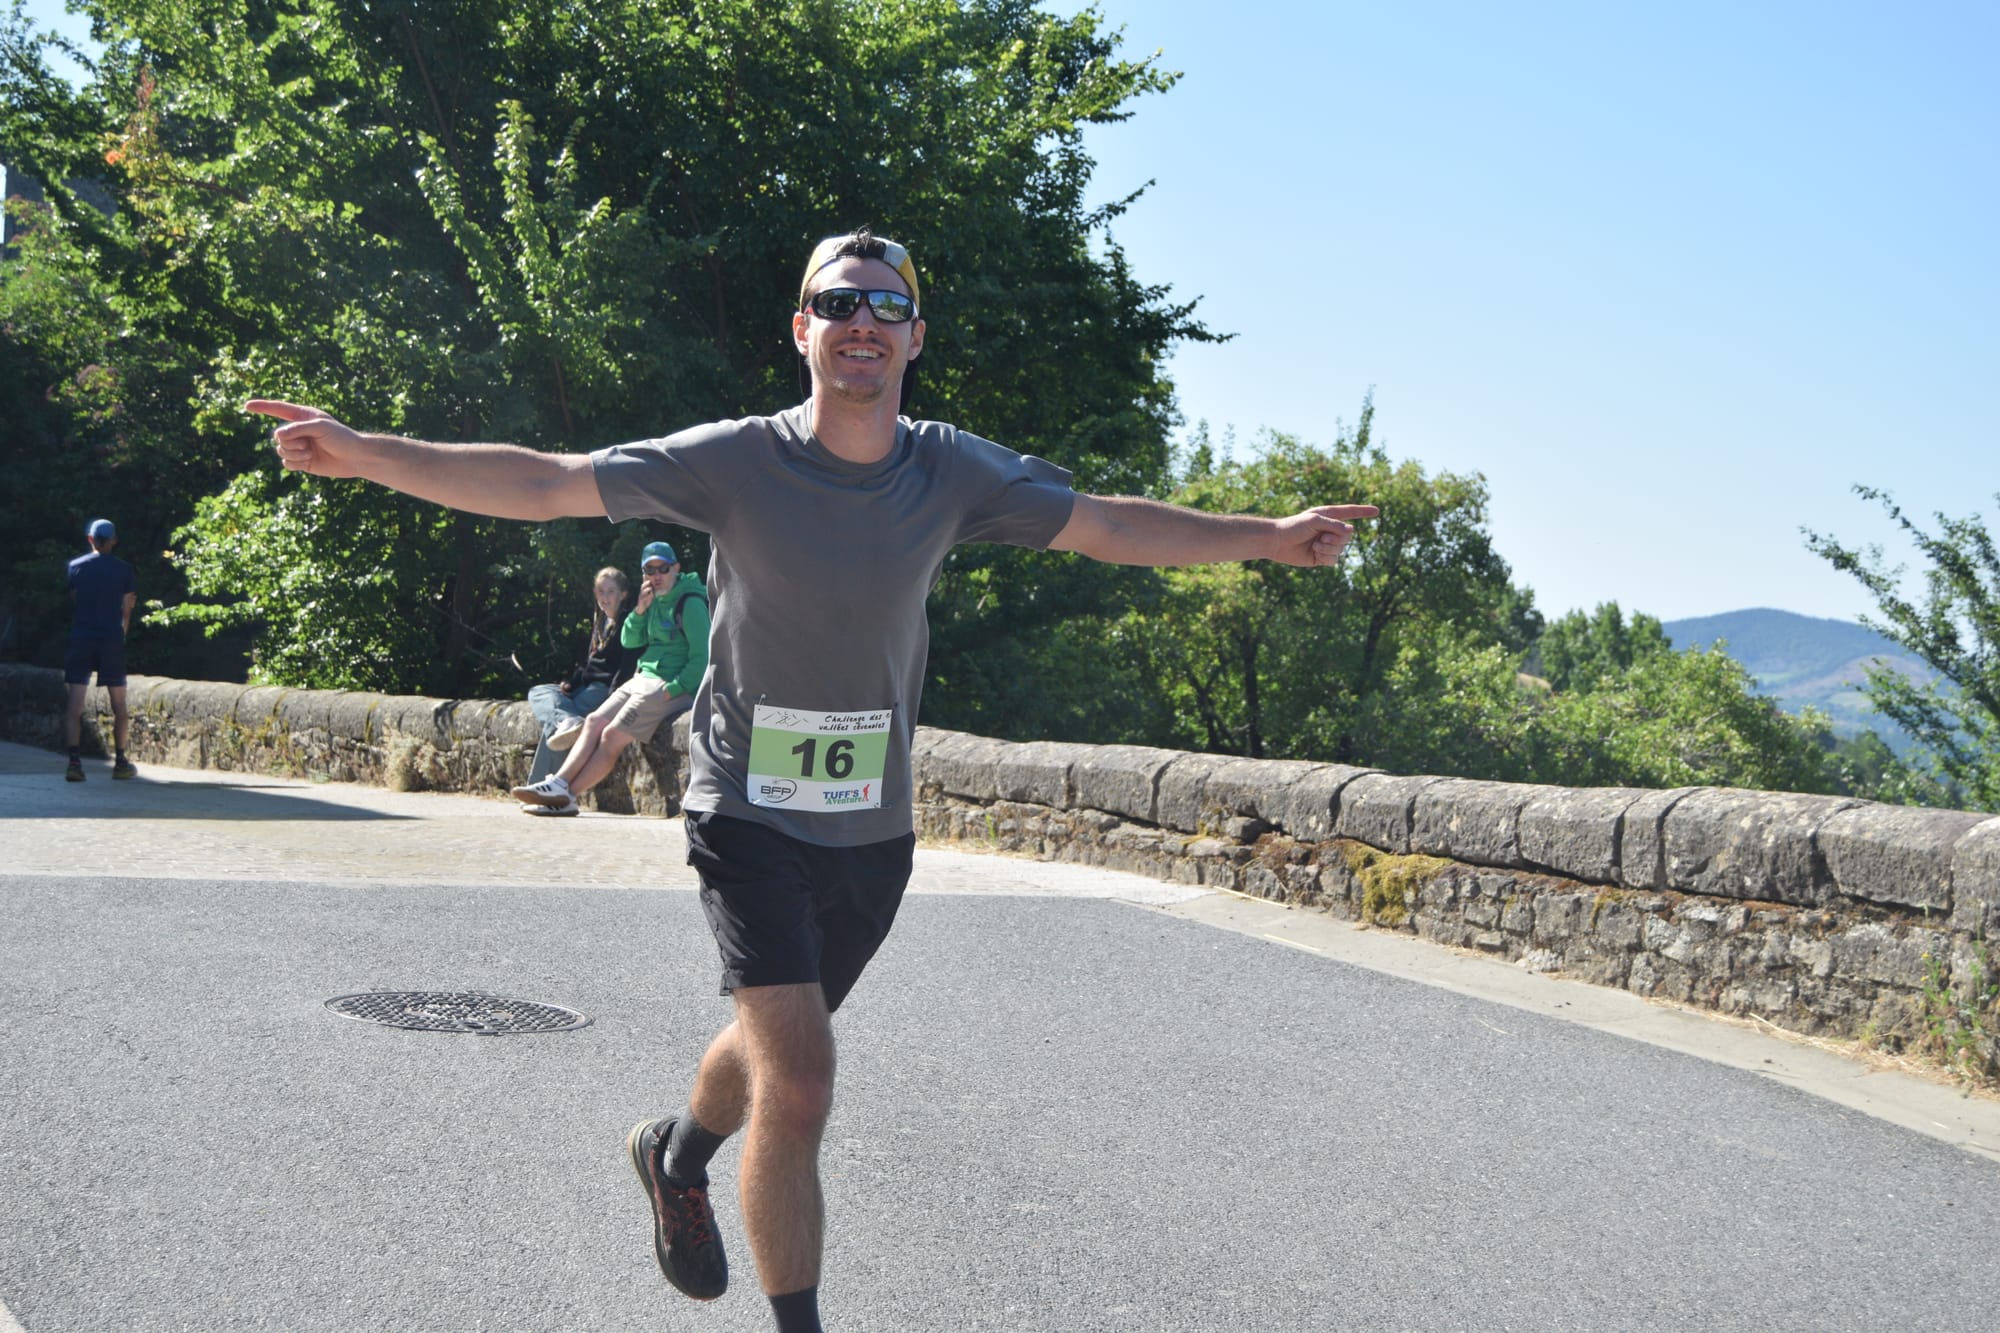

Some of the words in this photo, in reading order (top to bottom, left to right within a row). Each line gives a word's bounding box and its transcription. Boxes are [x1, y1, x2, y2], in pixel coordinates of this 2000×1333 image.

[824, 715, 866, 723] Challenge
[869, 713, 883, 721] des
[791, 738, 856, 779] 16
[760, 785, 792, 796] BFP
[822, 789, 860, 800] TUFF'S
